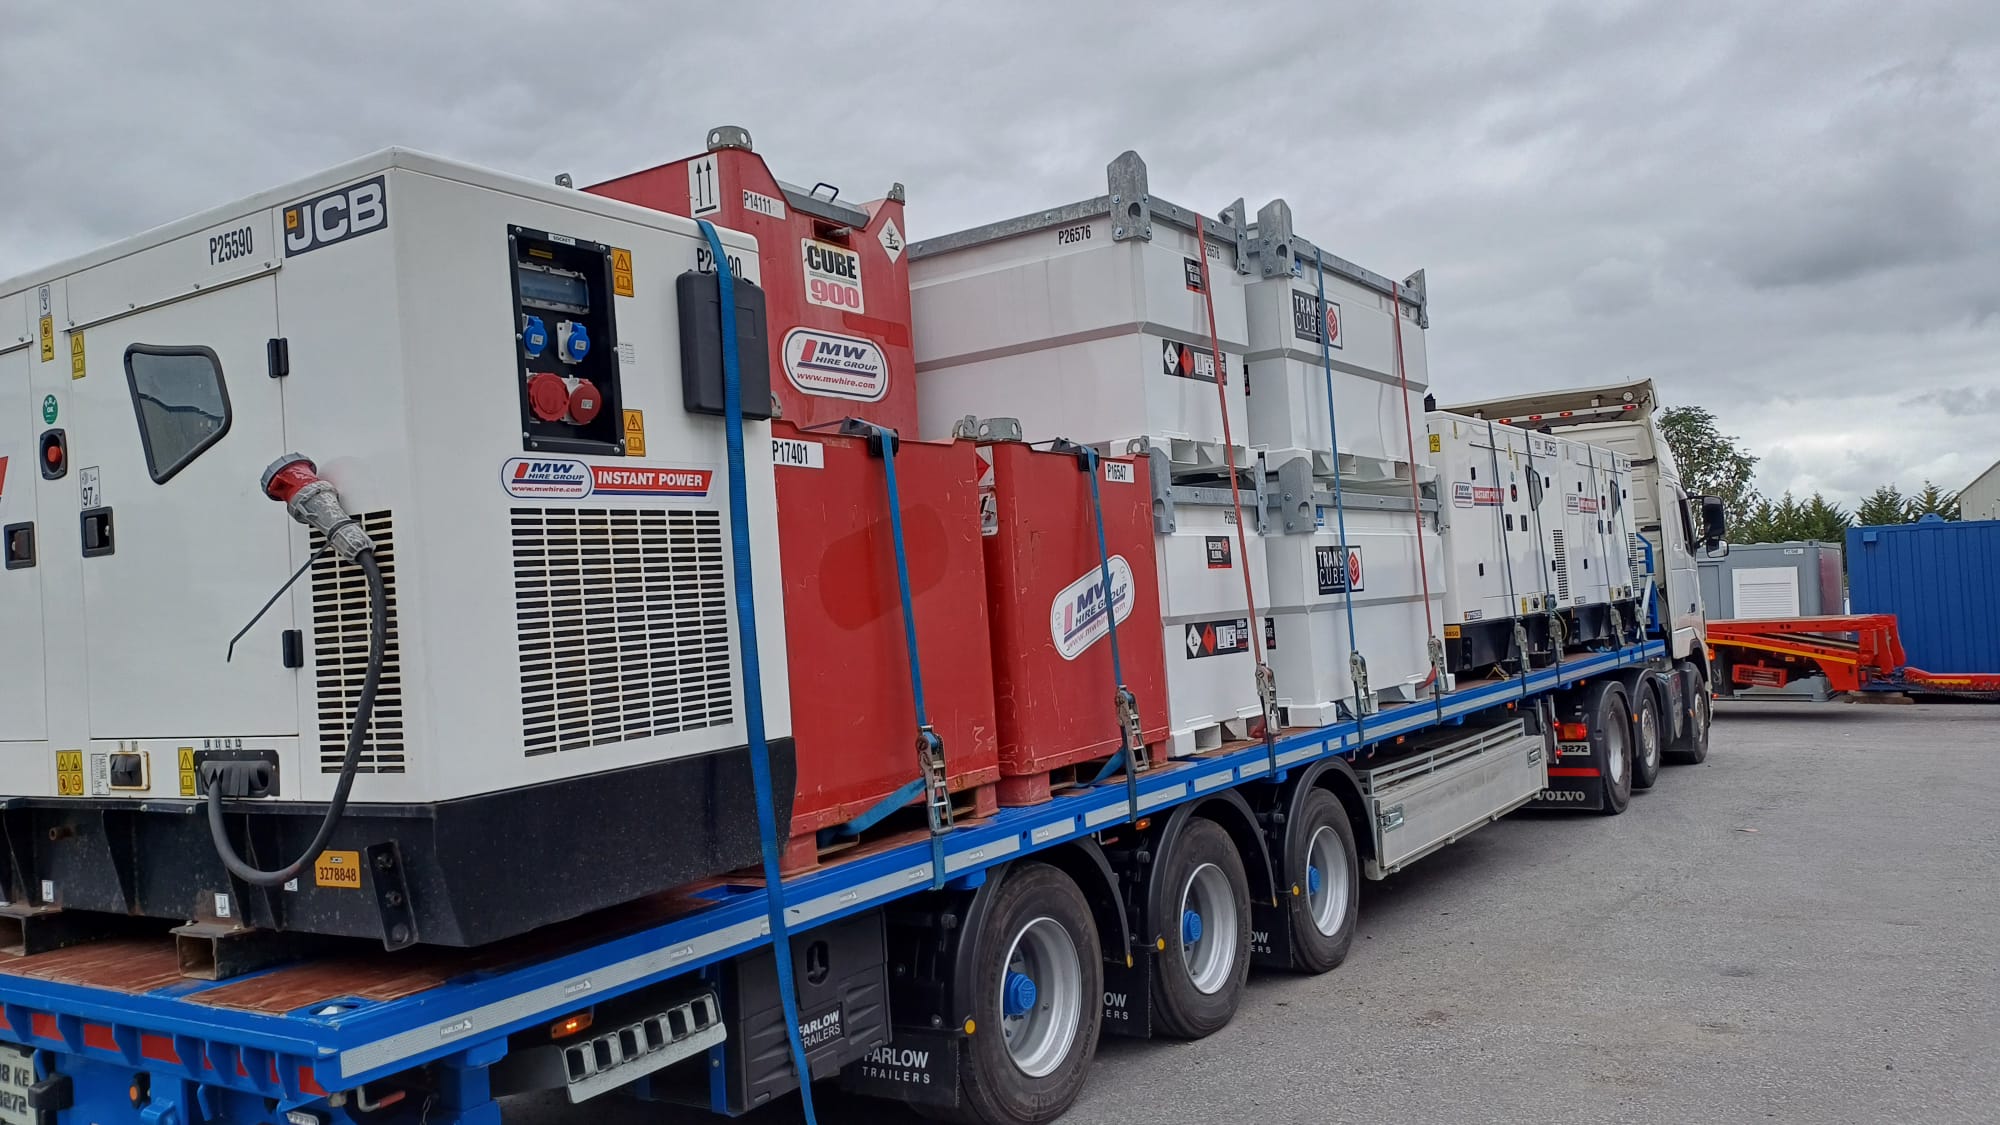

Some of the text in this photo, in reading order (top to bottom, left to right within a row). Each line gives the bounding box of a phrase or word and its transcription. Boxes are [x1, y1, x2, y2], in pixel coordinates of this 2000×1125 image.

[744, 191, 772, 214] P14111
[287, 183, 384, 251] JCB
[1058, 225, 1091, 245] P26576
[209, 226, 253, 265] P25590
[806, 245, 857, 280] CUBE
[811, 279, 860, 309] 900
[819, 341, 866, 361] MW
[815, 355, 878, 372] HIRE GROUP
[797, 371, 876, 390] www.mwhire.com
[771, 440, 808, 465] P17401
[531, 462, 574, 474] MW
[598, 471, 702, 487] INSTANT POWER
[82, 486, 93, 505] 97
[511, 485, 582, 493] www.mwhire.com
[1318, 551, 1343, 568] TRANS
[1319, 567, 1345, 585] CUBE
[1075, 583, 1127, 627] HIRE GOUP
[1561, 744, 1588, 753] 3272
[1539, 790, 1586, 801] VOLVO
[319, 867, 357, 882] 3278848
[14, 1066, 30, 1087] KE
[862, 1066, 931, 1084] TRAILERS
